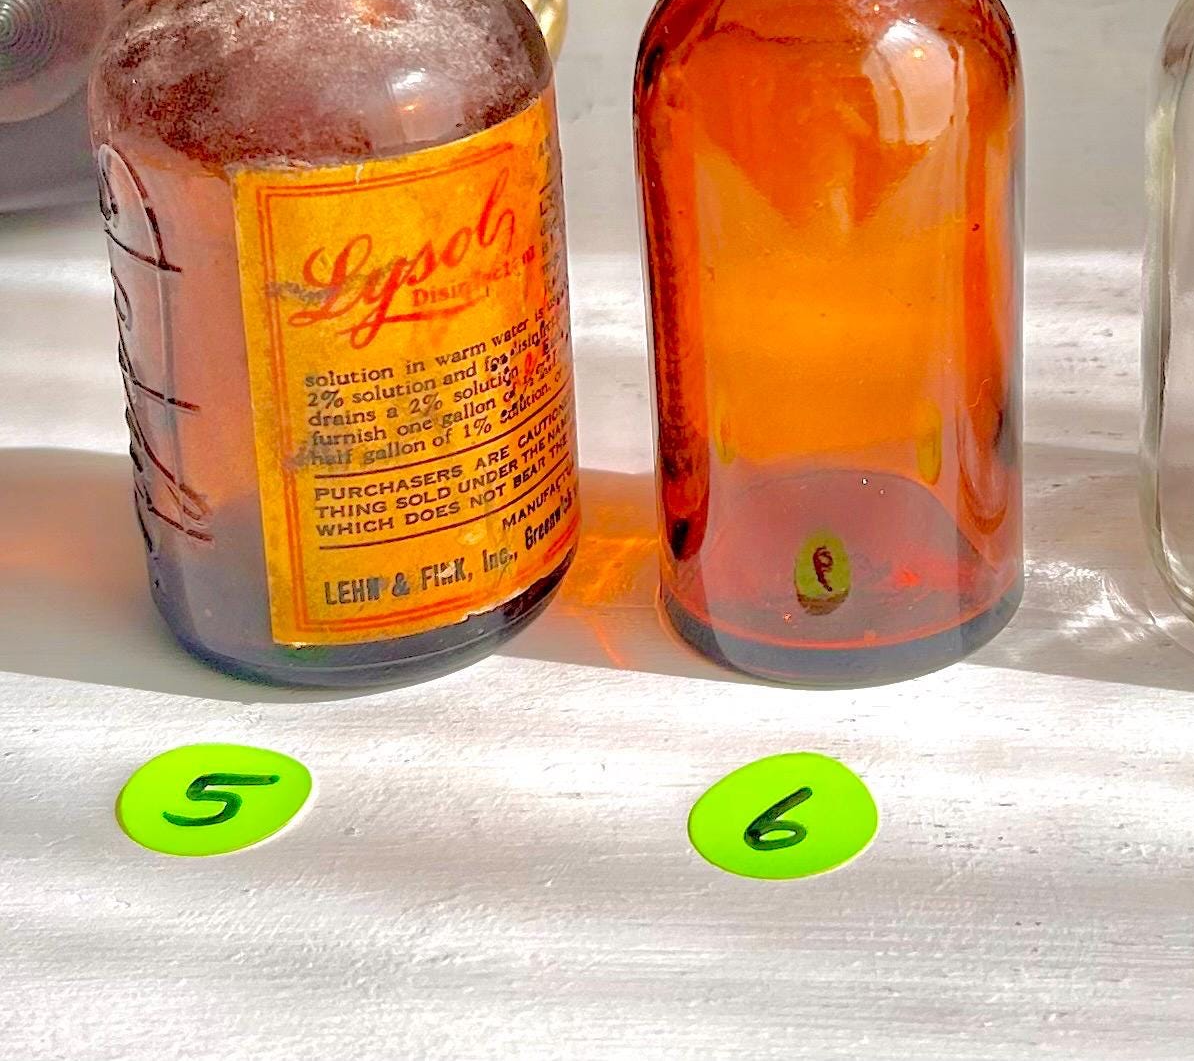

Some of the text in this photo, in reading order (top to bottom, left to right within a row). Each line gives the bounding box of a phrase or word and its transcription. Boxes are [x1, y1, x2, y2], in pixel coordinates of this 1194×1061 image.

[288, 167, 516, 349] Lysol
[304, 367, 395, 387] solution
[405, 359, 426, 375] in
[435, 341, 486, 366] warm
[491, 318, 529, 347] water
[307, 389, 345, 409] 2%
[351, 378, 437, 404] solution
[442, 361, 477, 386] and
[307, 409, 377, 427] drains
[385, 406, 399, 419] a
[408, 391, 444, 417] 2%
[311, 425, 388, 446] furnish
[396, 418, 434, 437] one
[441, 397, 497, 429] gallon
[362, 438, 427, 465] gallon
[431, 427, 454, 448] of
[463, 415, 493, 439] 1%
[314, 500, 388, 519] THING
[395, 486, 452, 510] SOLD
[457, 458, 519, 494] UNDER
[521, 436, 546, 464] THE
[315, 464, 463, 502] PURCHASERS
[473, 445, 511, 471] ARE
[315, 517, 395, 537] WHICH
[404, 501, 462, 526] DOES
[470, 483, 507, 509] NOT
[512, 456, 546, 489] BEAR
[391, 571, 411, 598] &
[162, 773, 281, 828] 5
[743, 786, 813, 852] 6
